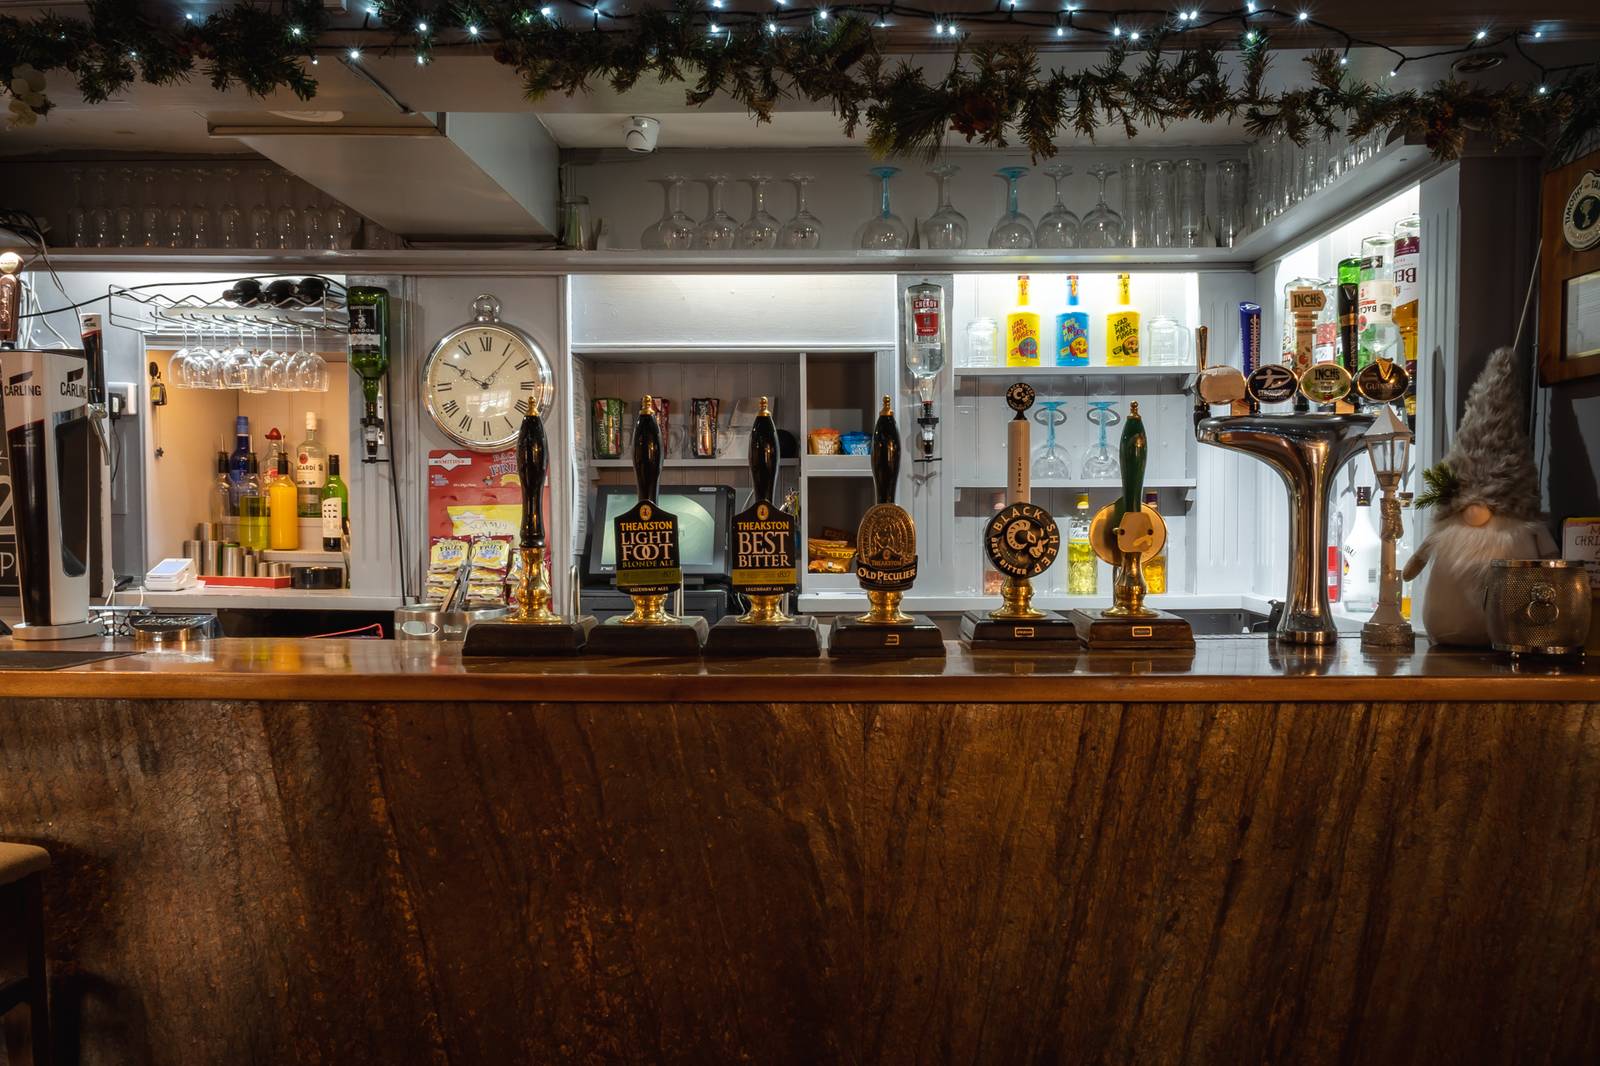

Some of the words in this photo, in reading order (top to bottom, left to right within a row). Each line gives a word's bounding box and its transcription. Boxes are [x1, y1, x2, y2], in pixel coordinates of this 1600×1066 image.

[1565, 184, 1583, 224] TIMOTHY
[4, 384, 42, 397] CARLING
[620, 521, 673, 532] THEAKSTON
[737, 521, 790, 531] THEAKSTON
[621, 530, 673, 545] LIGHT
[737, 530, 790, 555] BEST
[992, 506, 1043, 532] BLACK
[1034, 523, 1059, 574] SHEEP
[622, 543, 673, 561] FOOT
[991, 537, 1002, 558] BEST
[999, 559, 1028, 575] BITTER
[622, 561, 656, 569] BLONDE
[738, 554, 792, 568] BITTER
[857, 567, 876, 579] OLD
[877, 567, 916, 581] PECULIER
